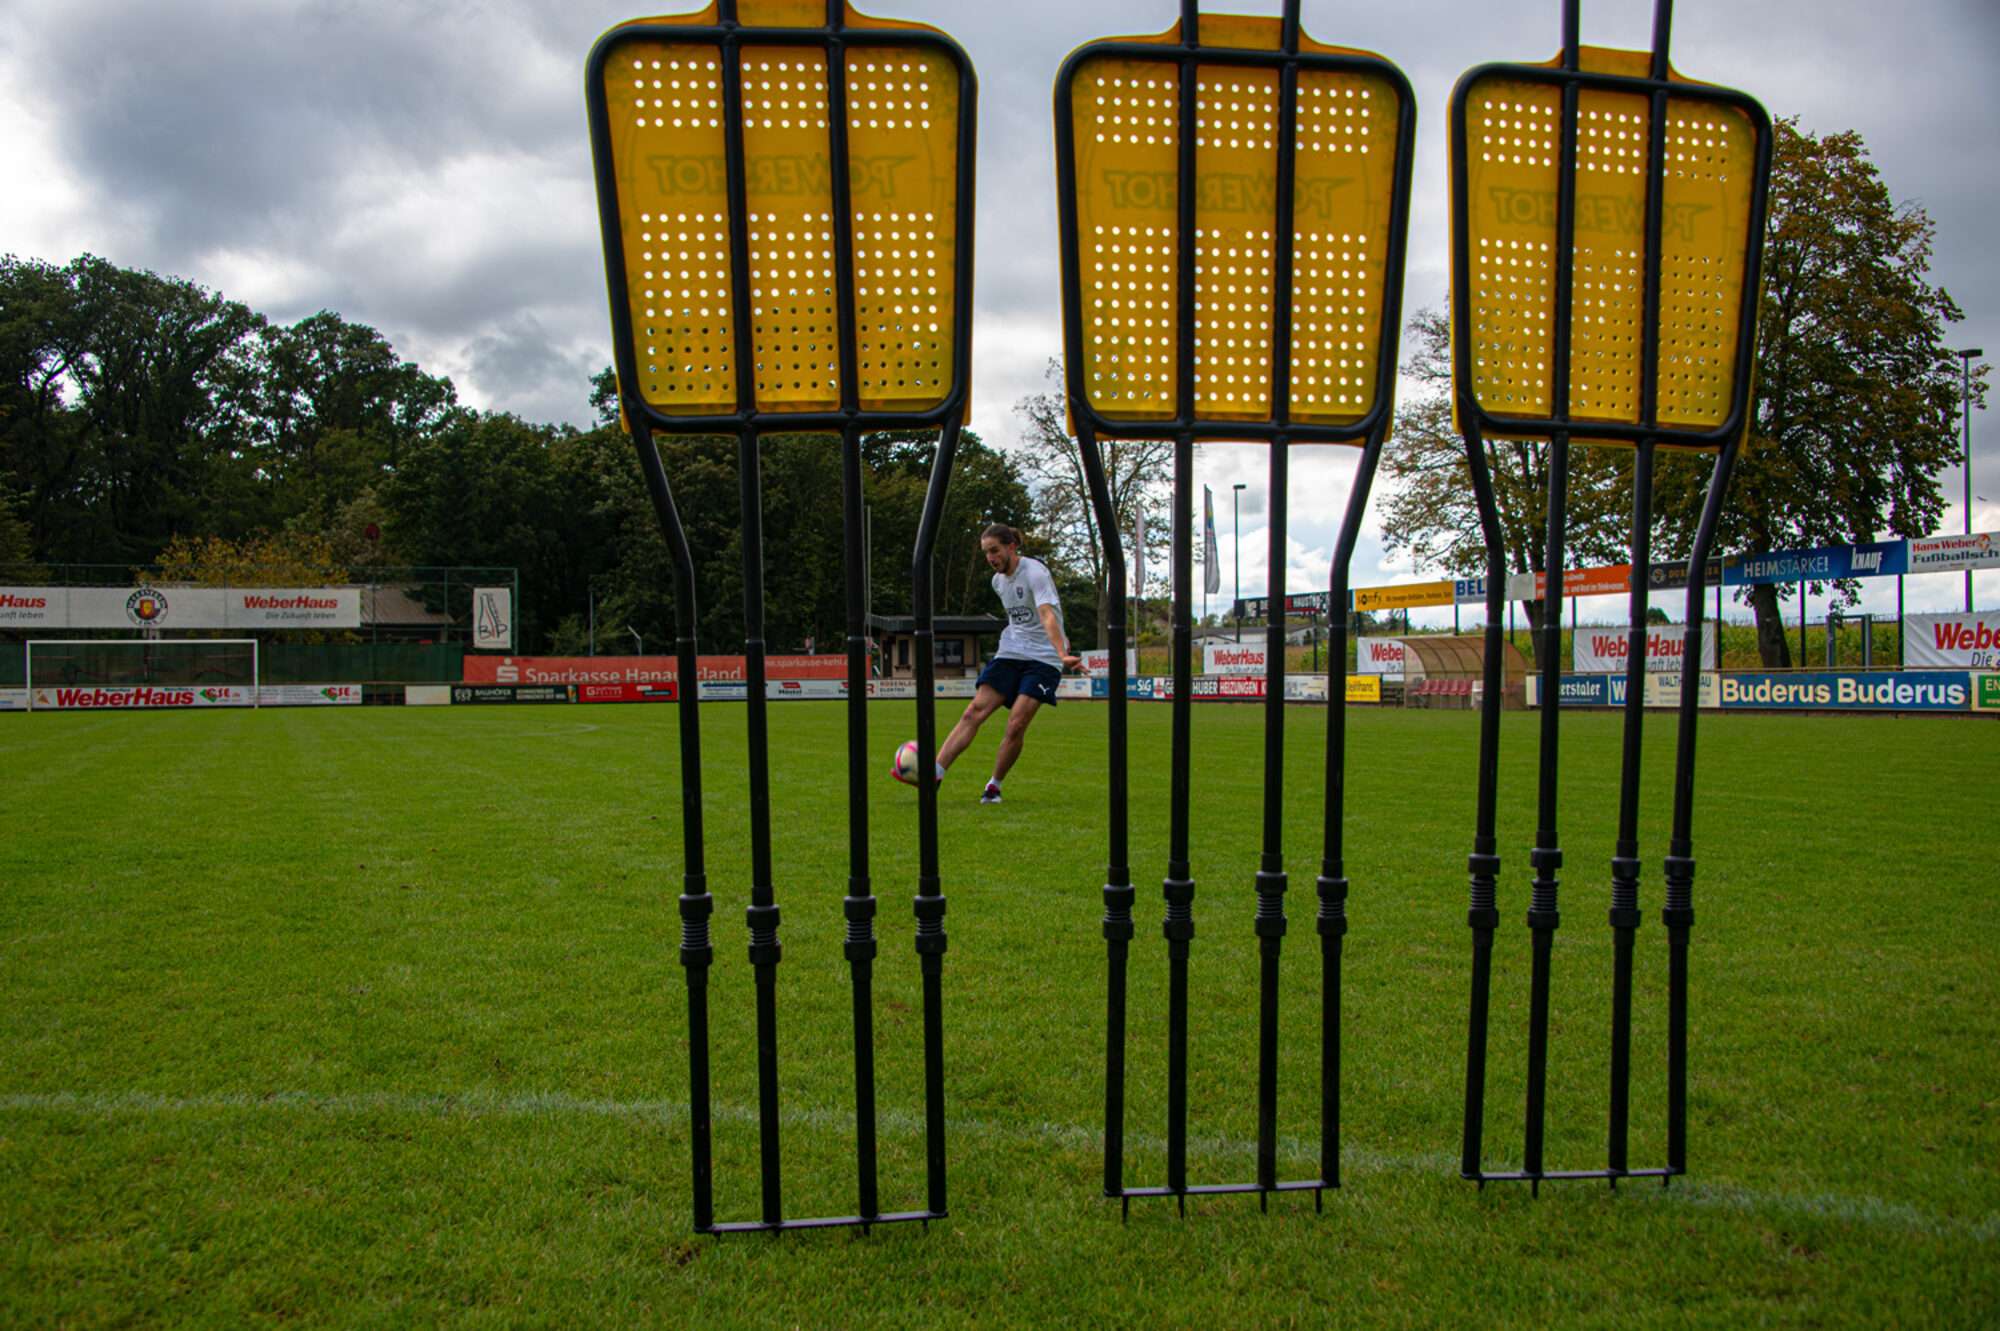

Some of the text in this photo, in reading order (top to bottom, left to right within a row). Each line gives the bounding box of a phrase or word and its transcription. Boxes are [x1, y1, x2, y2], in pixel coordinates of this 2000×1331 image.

[1941, 538, 1976, 550] Weber
[1743, 556, 1829, 578] HEIMSTÄRKE!
[244, 596, 337, 609] WeberHaus
[1214, 649, 1264, 666] WeberHaus
[526, 667, 622, 685] Sparkasse
[57, 688, 194, 706] WeberHaus
[1722, 679, 1830, 703] Buderus
[1838, 678, 1965, 704] Buderus
